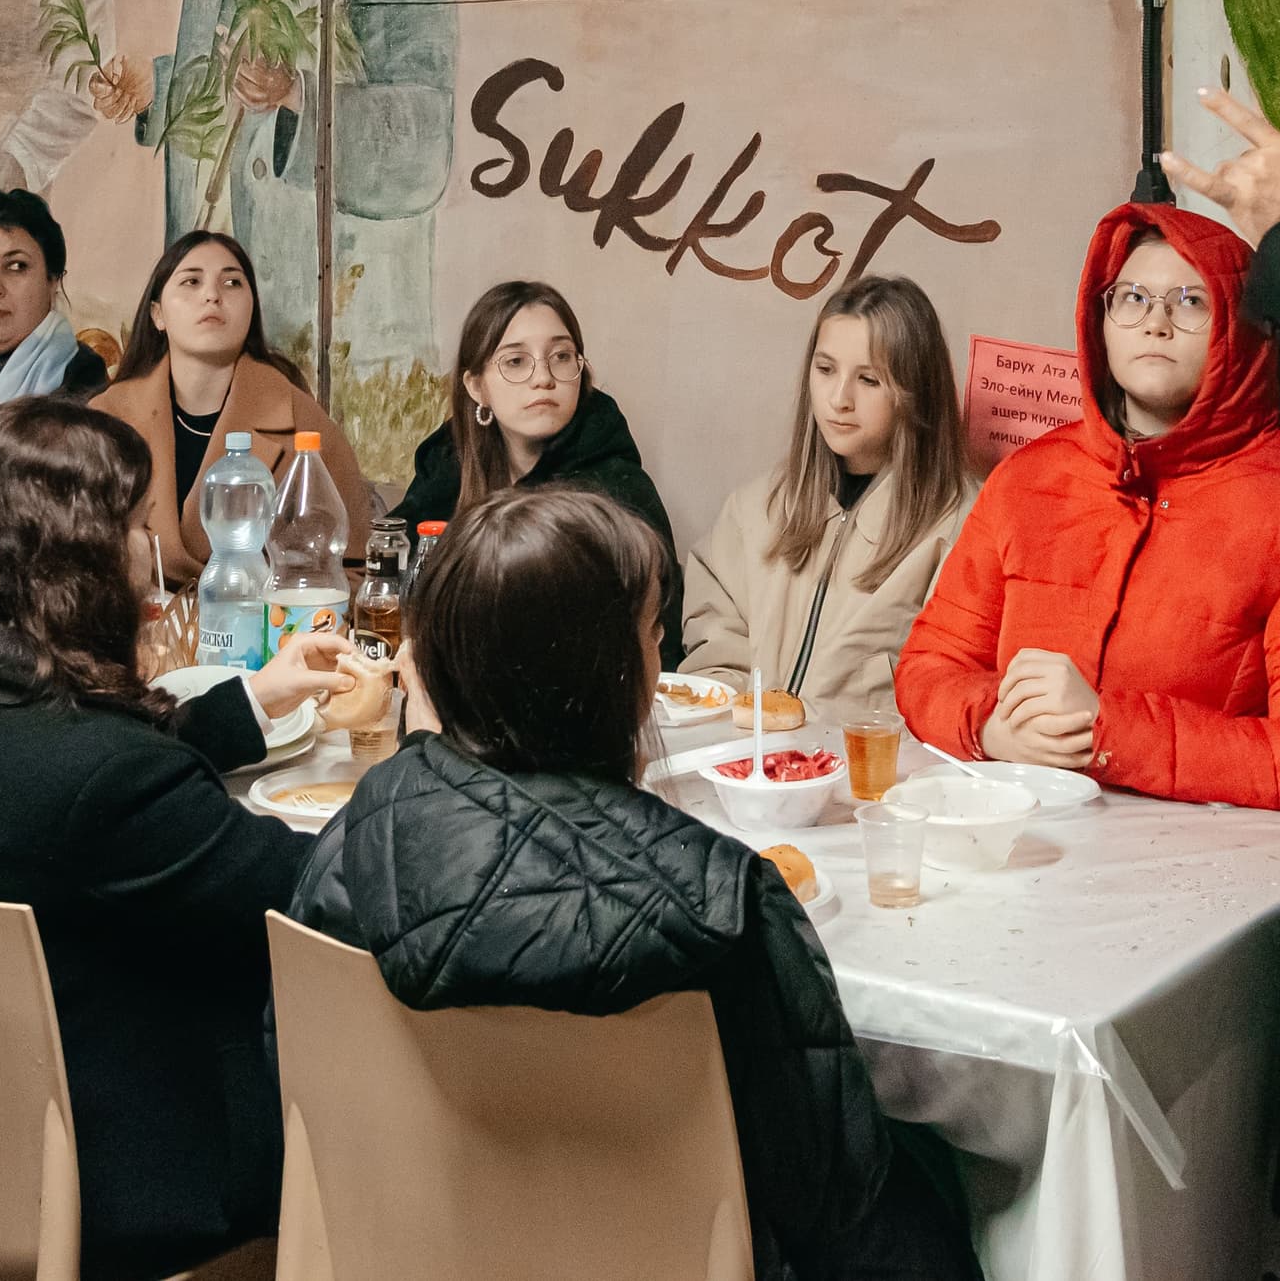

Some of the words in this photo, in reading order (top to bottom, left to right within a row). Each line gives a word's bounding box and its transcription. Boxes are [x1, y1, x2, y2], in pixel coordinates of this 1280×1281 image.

[470, 57, 1002, 301] Sukkot
[996, 354, 1035, 374] Барух
[1042, 363, 1066, 379] Ата
[980, 377, 1042, 402] Эло-ейну
[991, 406, 1027, 422] ашер
